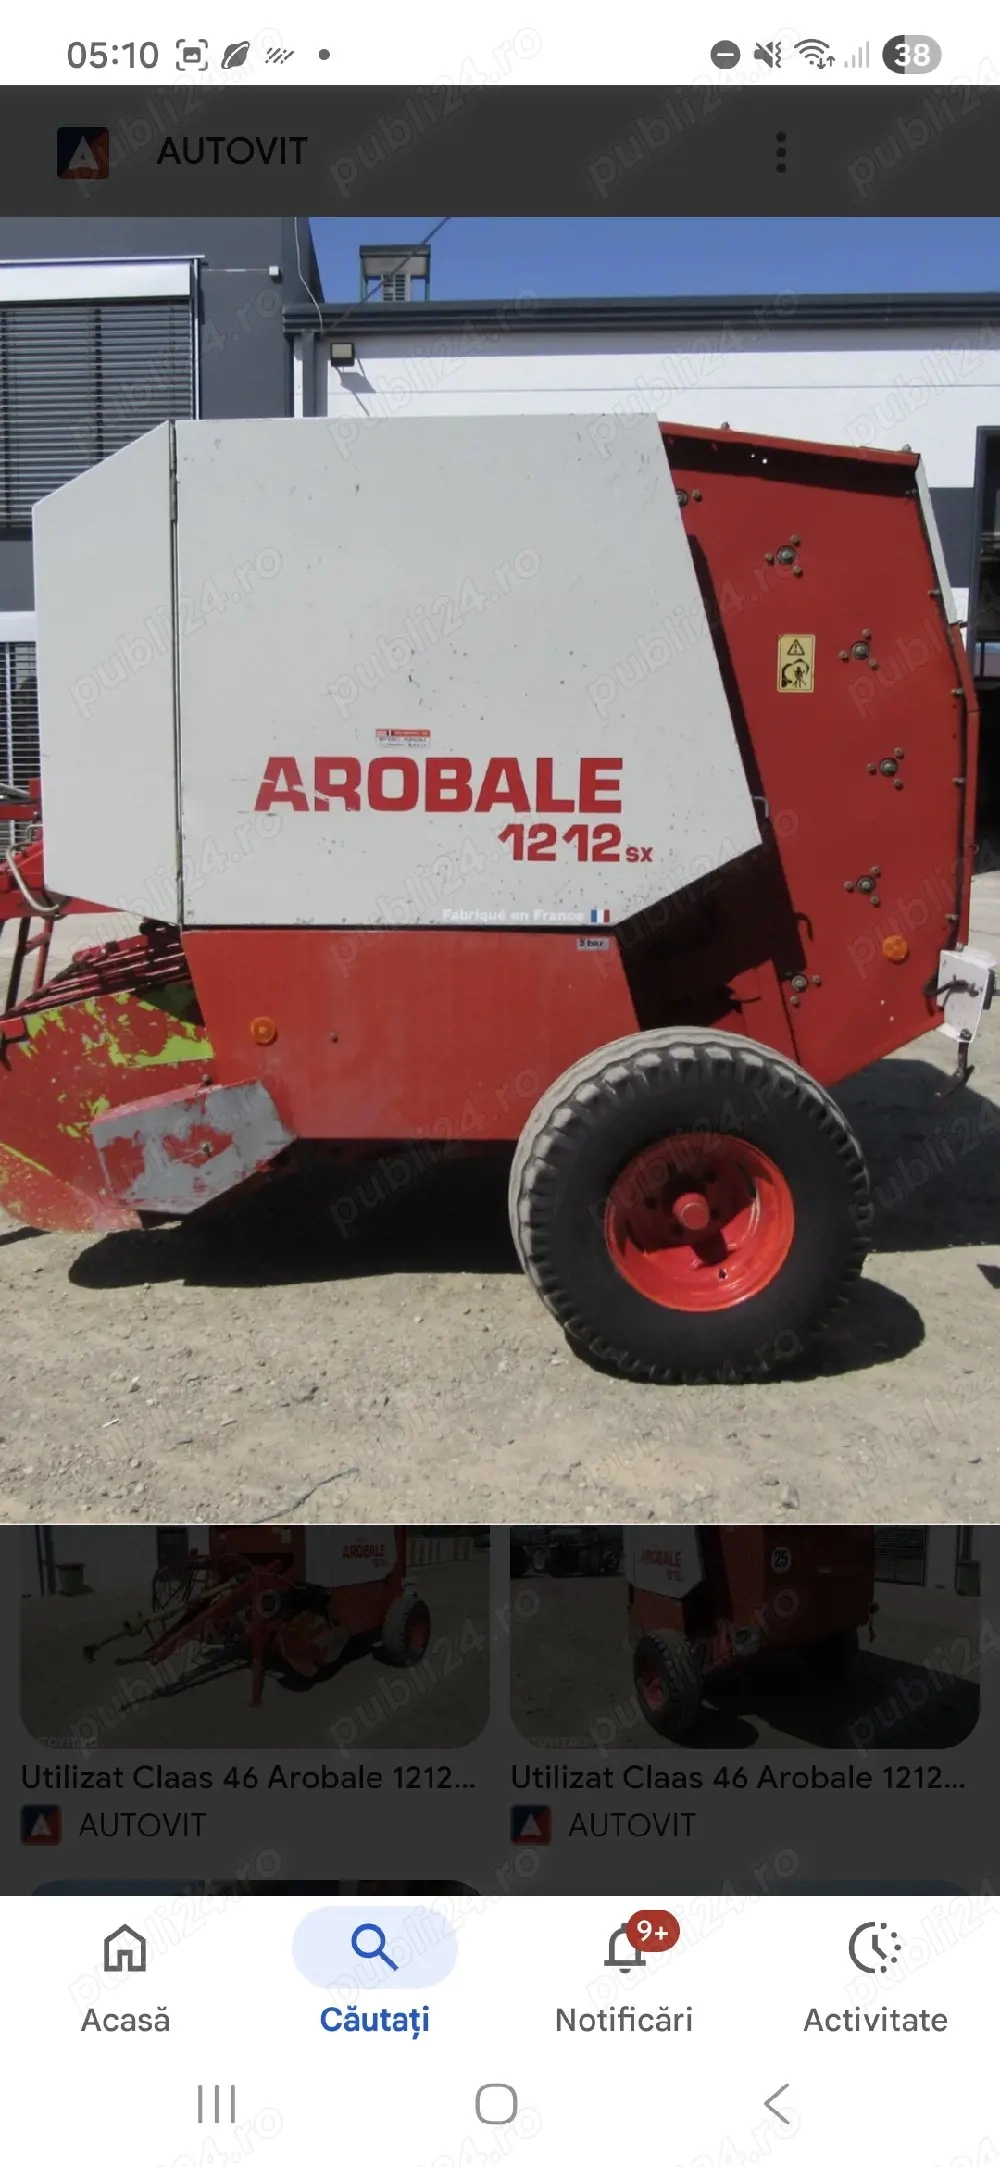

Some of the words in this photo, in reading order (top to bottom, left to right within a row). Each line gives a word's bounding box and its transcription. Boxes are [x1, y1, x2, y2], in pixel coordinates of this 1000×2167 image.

[67, 41, 159, 69] 05:10
[894, 43, 933, 69] 38
[156, 136, 309, 165] AUTOVIT
[255, 756, 624, 814] AROBALE
[498, 823, 622, 862] 1212
[441, 908, 507, 924] Fabriqué
[510, 910, 529, 922] en
[533, 909, 585, 922] France
[774, 1549, 789, 1568] 25
[21, 1764, 124, 1789] Utilizat
[132, 1764, 213, 1789] Claas
[222, 1765, 258, 1789] 46
[267, 1764, 383, 1789] Arobale
[393, 1765, 476, 1789] 1212...
[511, 1764, 614, 1789] Utilizat
[622, 1764, 703, 1789] Claas
[712, 1765, 748, 1789] 46
[756, 1764, 873, 1789] Arobale
[882, 1765, 966, 1789] 1212...
[79, 1812, 207, 1837] AUTOVIT
[568, 1812, 696, 1837] AUTOVIT
[637, 1921, 669, 1944] 9+
[80, 2005, 170, 2033] Acasă
[320, 2005, 430, 2040] Căutați
[555, 2005, 693, 2033] Notificări
[803, 2005, 948, 2033] Activitate
